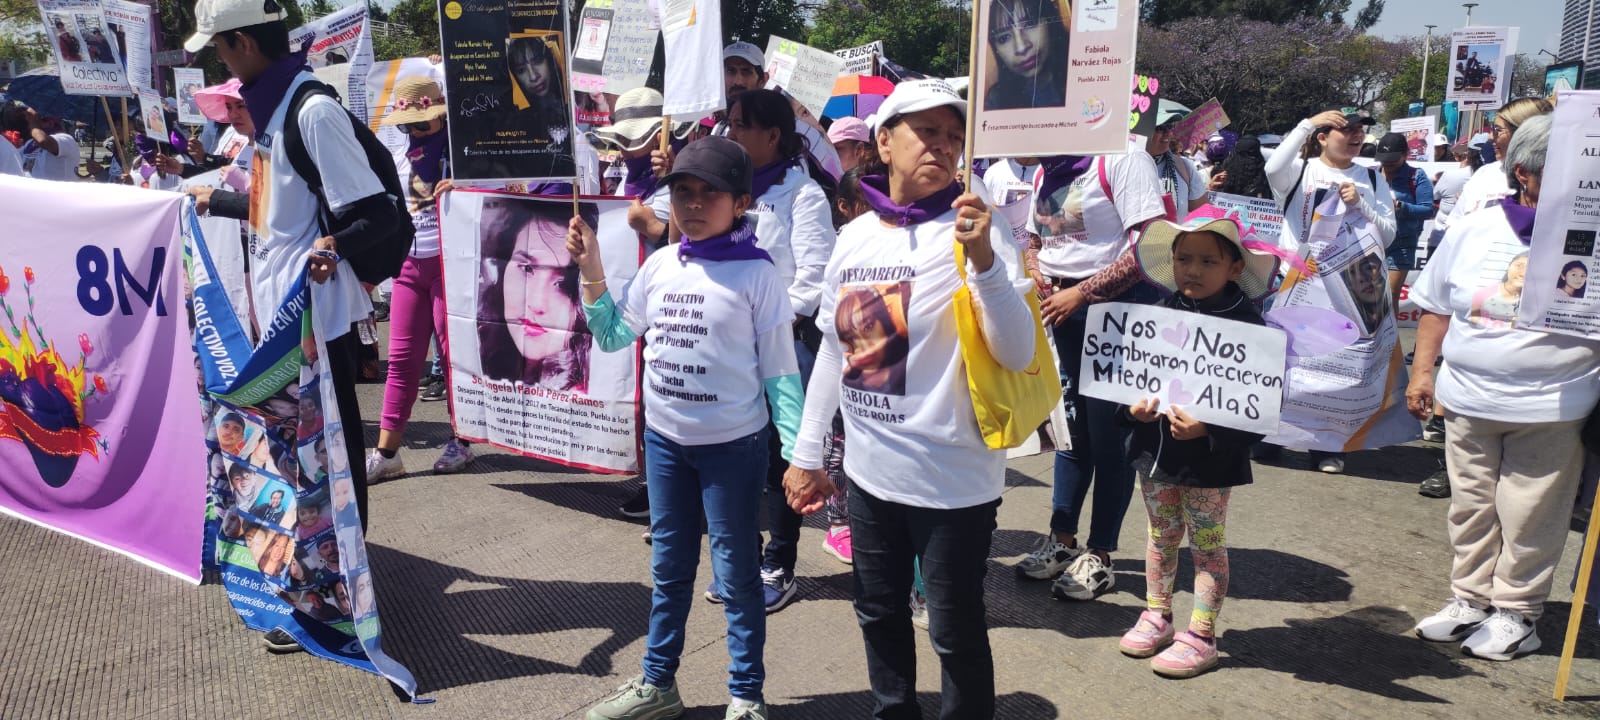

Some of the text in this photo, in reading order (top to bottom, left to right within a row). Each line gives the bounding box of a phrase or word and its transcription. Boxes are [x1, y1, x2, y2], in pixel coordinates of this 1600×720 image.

[849, 43, 880, 59] BUSCA
[1085, 45, 1110, 54] Fabiola
[1072, 56, 1122, 67] Narváez Rojas
[1250, 199, 1276, 208] COLECTIVO
[1574, 202, 1593, 210] Mayo
[76, 244, 168, 317] 8M
[663, 293, 705, 305] COLECTIVO
[274, 308, 294, 332] EN
[679, 308, 690, 318] de
[691, 308, 704, 321] los
[194, 296, 239, 380] COLECTIVO VOZ
[1102, 311, 1247, 364] Nos Nos
[1084, 333, 1189, 374] Sembraron
[1194, 354, 1283, 389] Crecieron
[683, 364, 694, 374] en
[696, 364, 706, 375] la
[1092, 359, 1162, 394] Miedo
[517, 384, 544, 398] Paola
[572, 393, 605, 409] Ramos
[501, 396, 516, 404] Abril
[525, 399, 540, 408] 2017
[591, 411, 611, 423] Puebla
[618, 416, 629, 425] los
[496, 406, 513, 415] desde
[539, 411, 544, 420] la
[571, 420, 592, 429] estado
[610, 426, 630, 436] hecho
[522, 420, 532, 429] dar
[580, 443, 585, 451] y
[596, 446, 605, 454] las
[239, 576, 249, 588] de
[249, 578, 260, 591] los
[265, 602, 276, 612] en
